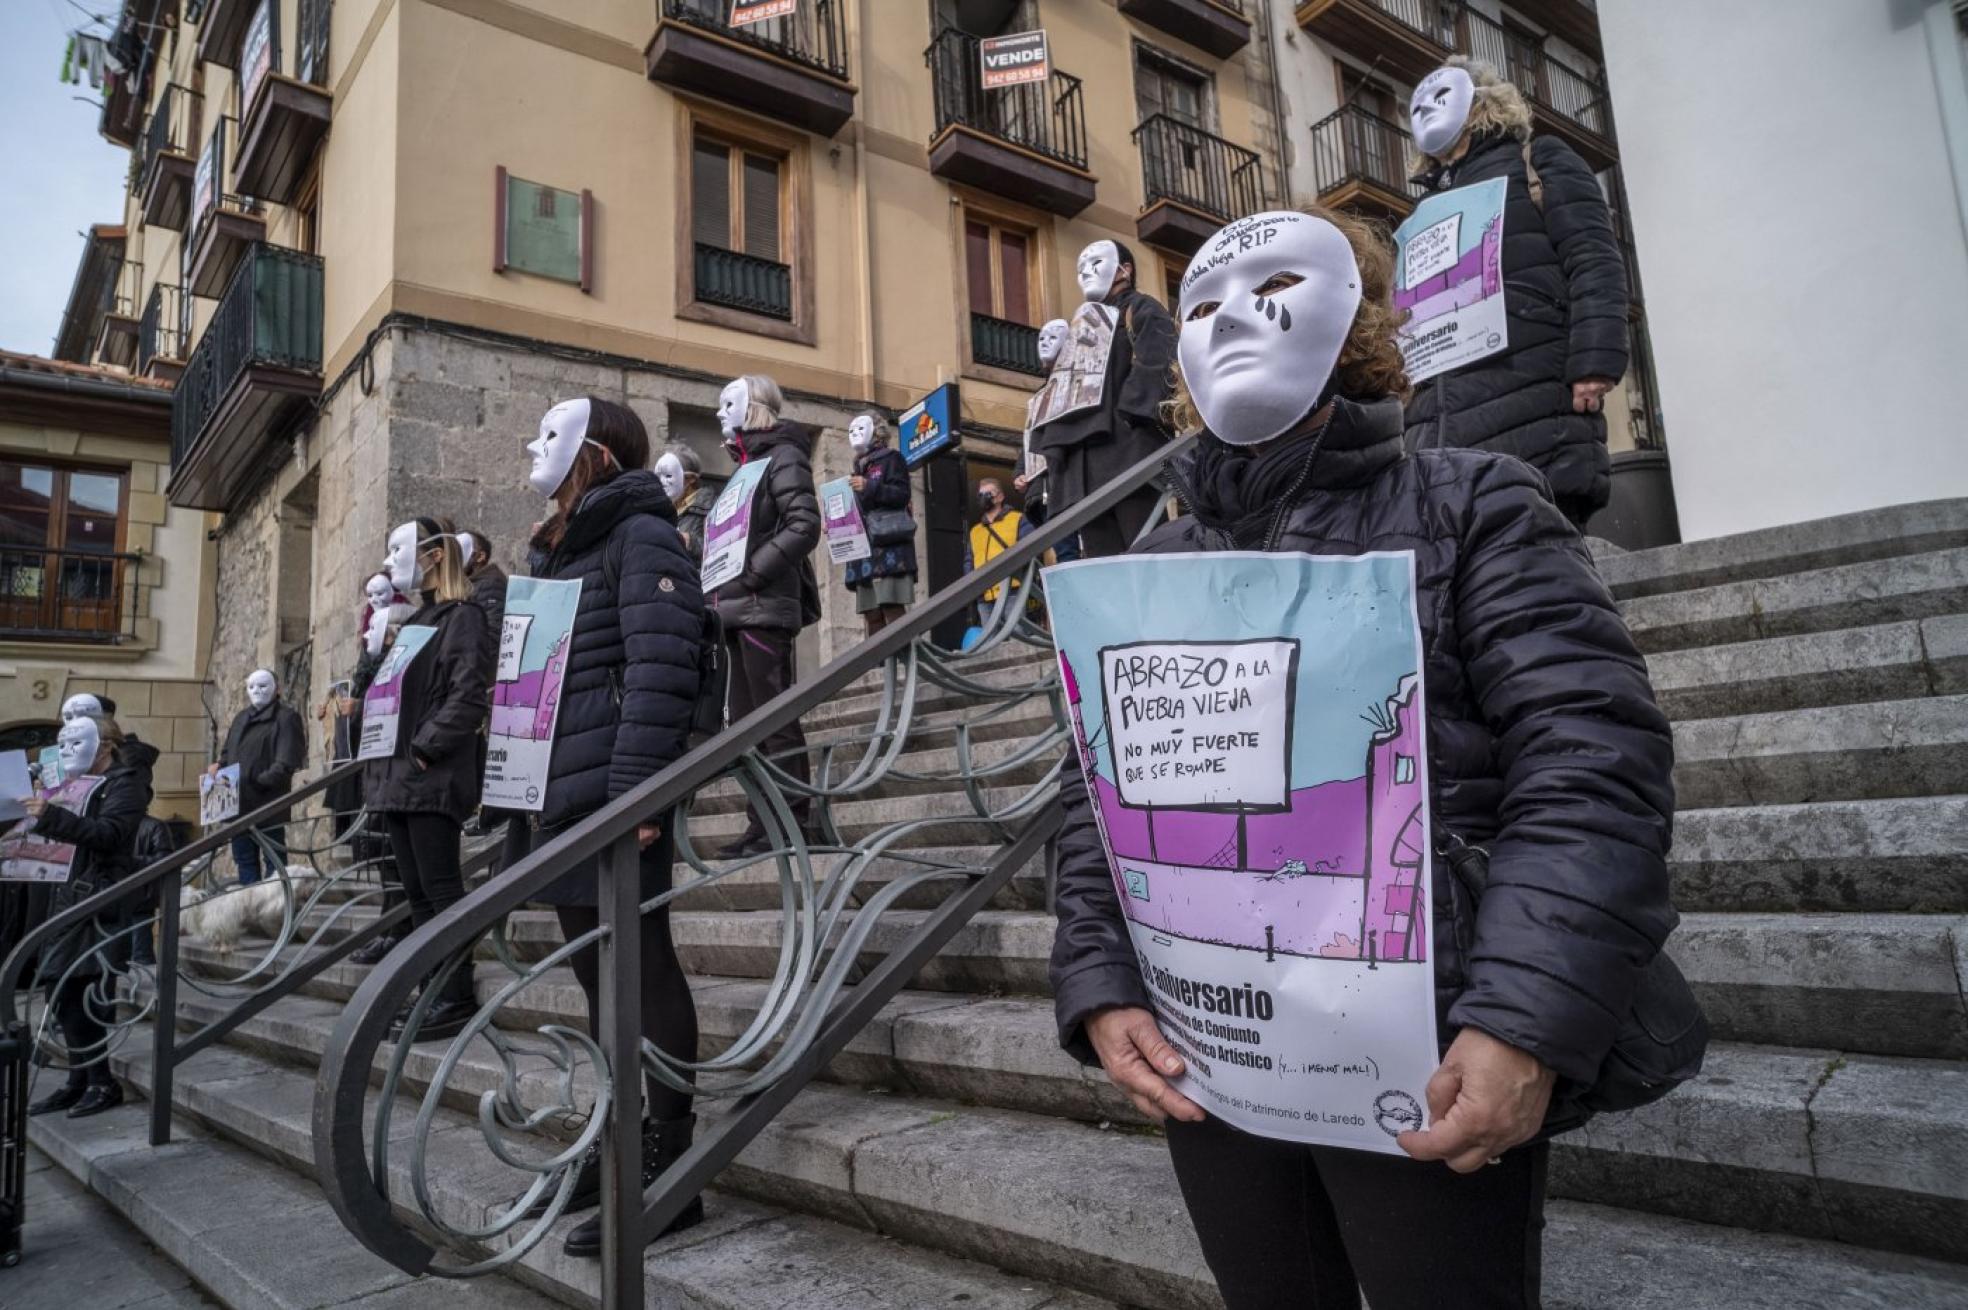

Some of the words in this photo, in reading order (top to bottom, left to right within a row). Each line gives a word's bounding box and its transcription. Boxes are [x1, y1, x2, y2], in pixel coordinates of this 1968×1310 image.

[986, 48, 1044, 68] VENDE
[1114, 654, 1228, 694] ABRAZO
[1236, 662, 1246, 678] A
[1254, 659, 1270, 676] LA
[33, 680, 49, 700] 3
[1120, 695, 1184, 730] PUEBLA
[1193, 687, 1252, 716] VIEJA
[1124, 743, 1142, 761] NO
[1150, 735, 1182, 755] MUY
[1192, 731, 1259, 751] FUERTE
[1126, 765, 1144, 783] QUE
[1150, 762, 1169, 779] SE
[1174, 759, 1226, 778] ROMPE
[1155, 968, 1273, 1021] aniversario
[1205, 1019, 1261, 1045] Conjunto
[1244, 1100, 1300, 1121] Patrimonio
[1304, 1108, 1318, 1122] de
[1322, 1111, 1366, 1128] Laredo
